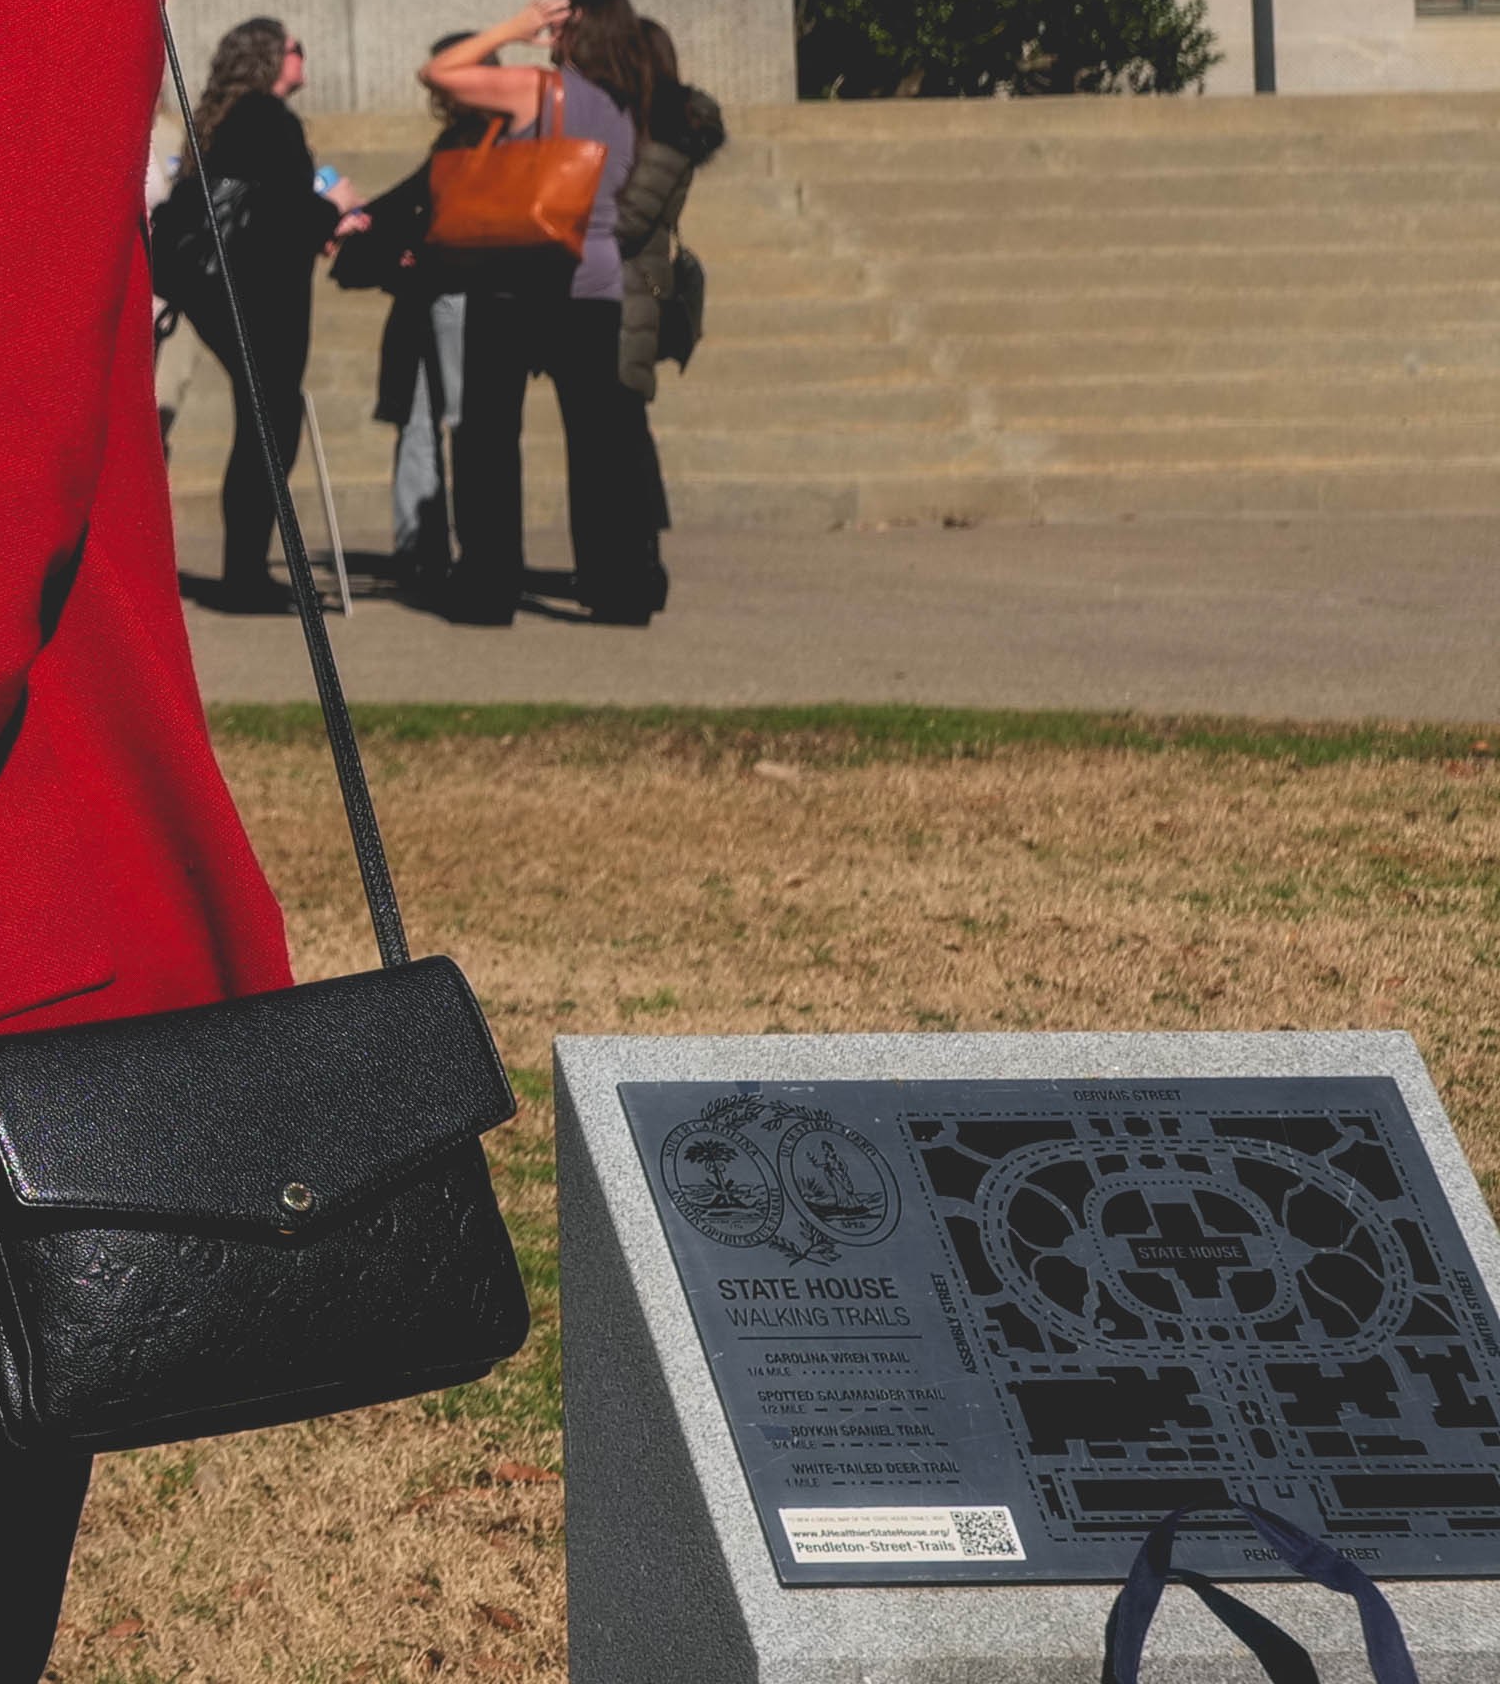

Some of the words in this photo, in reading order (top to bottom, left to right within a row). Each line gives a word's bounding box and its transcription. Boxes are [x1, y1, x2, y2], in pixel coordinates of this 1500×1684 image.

[1073, 1090, 1130, 1101] GERVAIS
[1132, 1089, 1181, 1101] STREET
[1138, 1246, 1188, 1259] STATE
[1188, 1245, 1243, 1258] HOUSE
[718, 1278, 800, 1301] STATE
[805, 1277, 899, 1299] HOUSE
[930, 1272, 957, 1314] STREET
[1451, 1268, 1482, 1310] STREET
[725, 1307, 829, 1327] WALKING
[833, 1306, 911, 1326] TRAILS
[946, 1316, 979, 1374] ASSEMBLY
[765, 1353, 829, 1364] CAROLINA
[832, 1352, 870, 1364] WREN
[871, 1352, 911, 1363] TRAIL
[766, 1367, 792, 1377] MILE
[757, 1390, 814, 1402] SPOTTED
[817, 1389, 907, 1402] SALAMANDER
[908, 1389, 946, 1401] TRAIL
[762, 1405, 778, 1414] 1/2
[780, 1404, 806, 1414] MILE
[791, 1425, 839, 1437] BOYKIN
[841, 1425, 894, 1436] SPANIEL
[898, 1424, 935, 1436] TRAIL
[790, 1440, 817, 1450] MILE
[792, 1463, 883, 1475] WHITE-TAILED
[885, 1463, 920, 1474] DEER
[921, 1461, 961, 1473] TRAIL
[794, 1478, 821, 1488] MILE
[791, 1527, 950, 1538] www.AHealthierStateHouse.org/
[796, 1540, 956, 1554] Pendleton-Street-Trails
